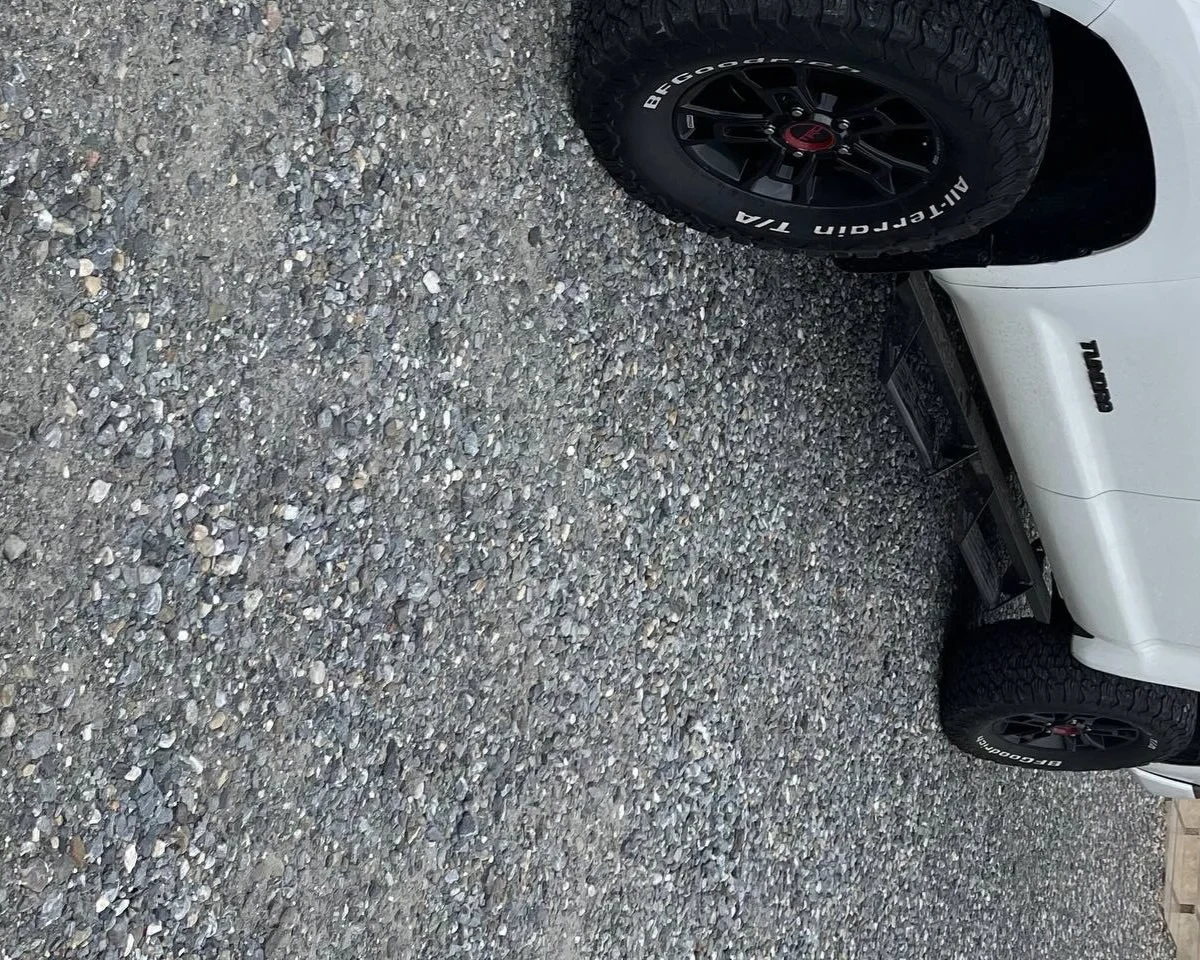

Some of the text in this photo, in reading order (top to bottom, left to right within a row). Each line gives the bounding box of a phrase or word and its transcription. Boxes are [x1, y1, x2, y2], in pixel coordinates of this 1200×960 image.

[734, 175, 970, 238] All-Terrain T/A
[1080, 340, 1113, 413] TUNDRA
